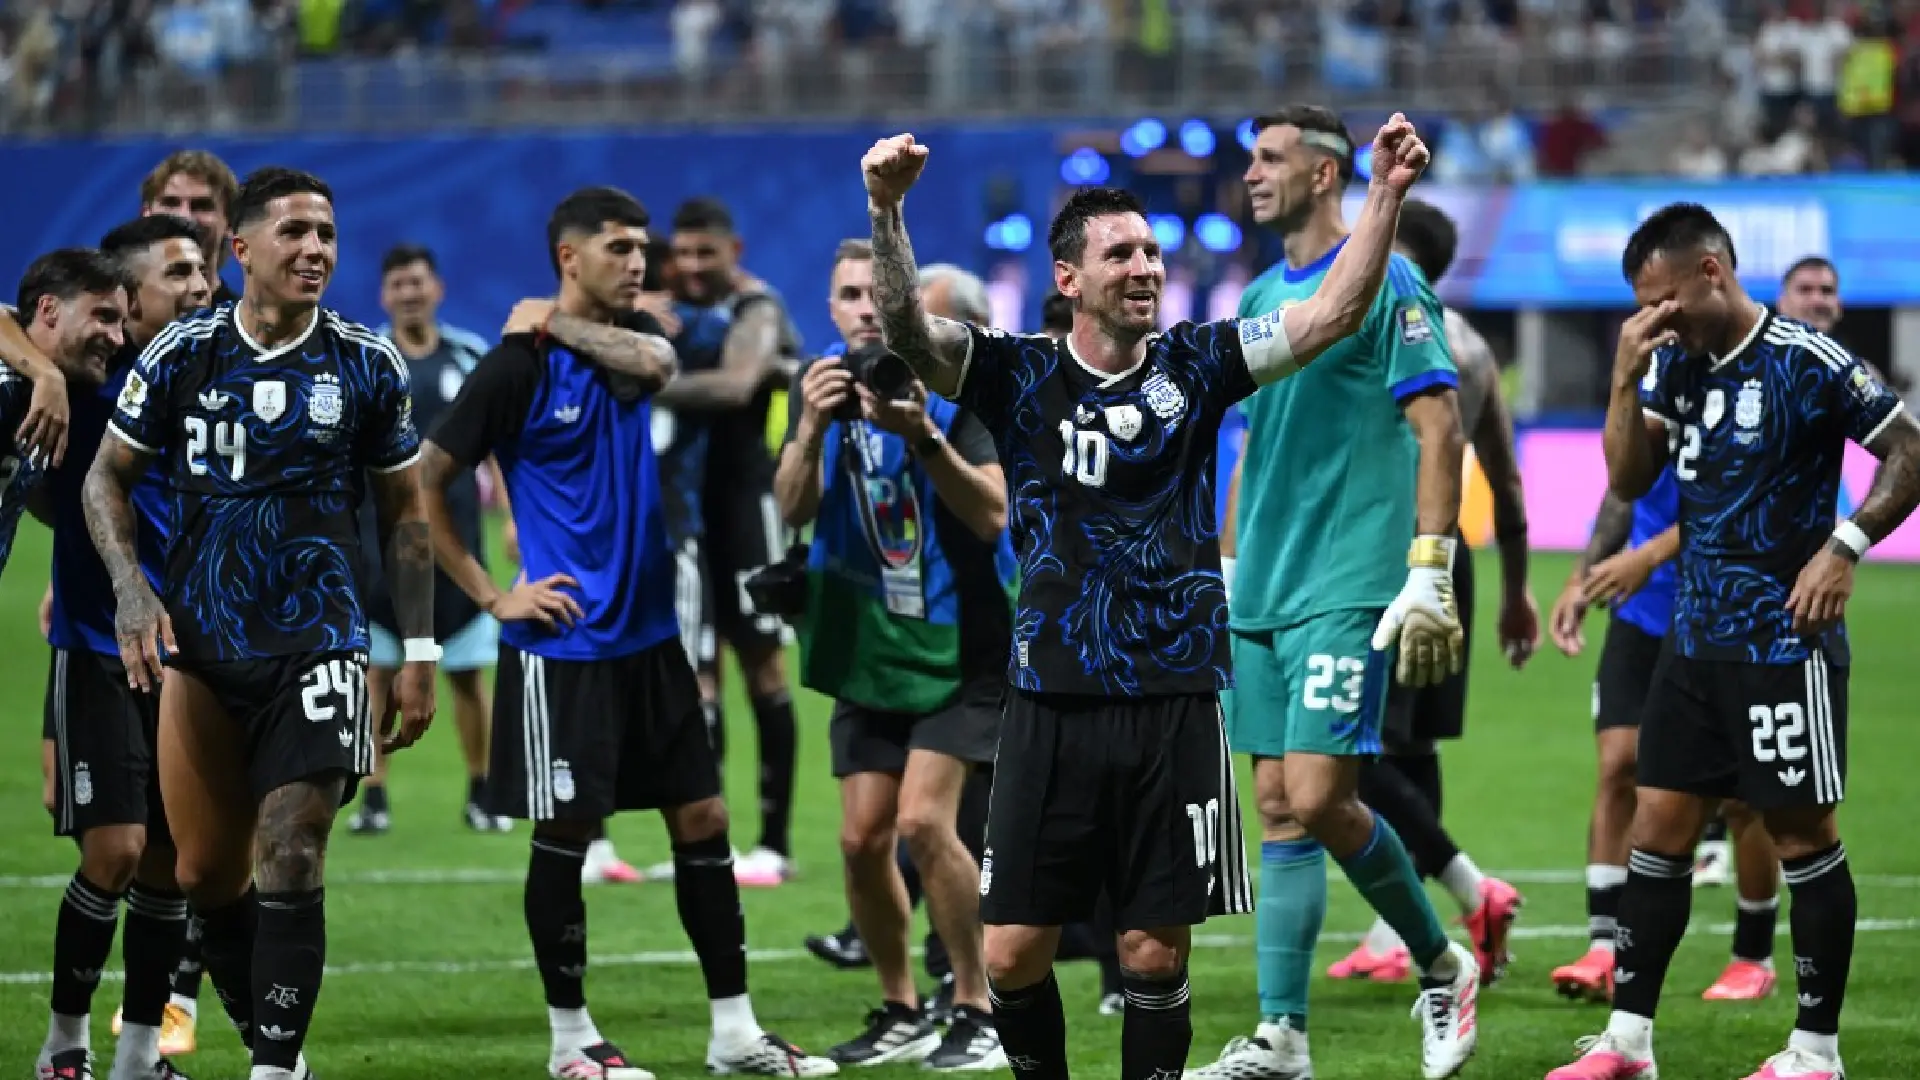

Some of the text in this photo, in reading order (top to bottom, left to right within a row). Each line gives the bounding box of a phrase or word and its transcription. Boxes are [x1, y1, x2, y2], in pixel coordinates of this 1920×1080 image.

[184, 415, 247, 482] 24
[1058, 418, 1109, 488] 10
[300, 659, 356, 722] 24
[1303, 652, 1364, 714] 23
[1748, 702, 1808, 762] 22
[1185, 798, 1219, 869] 10
